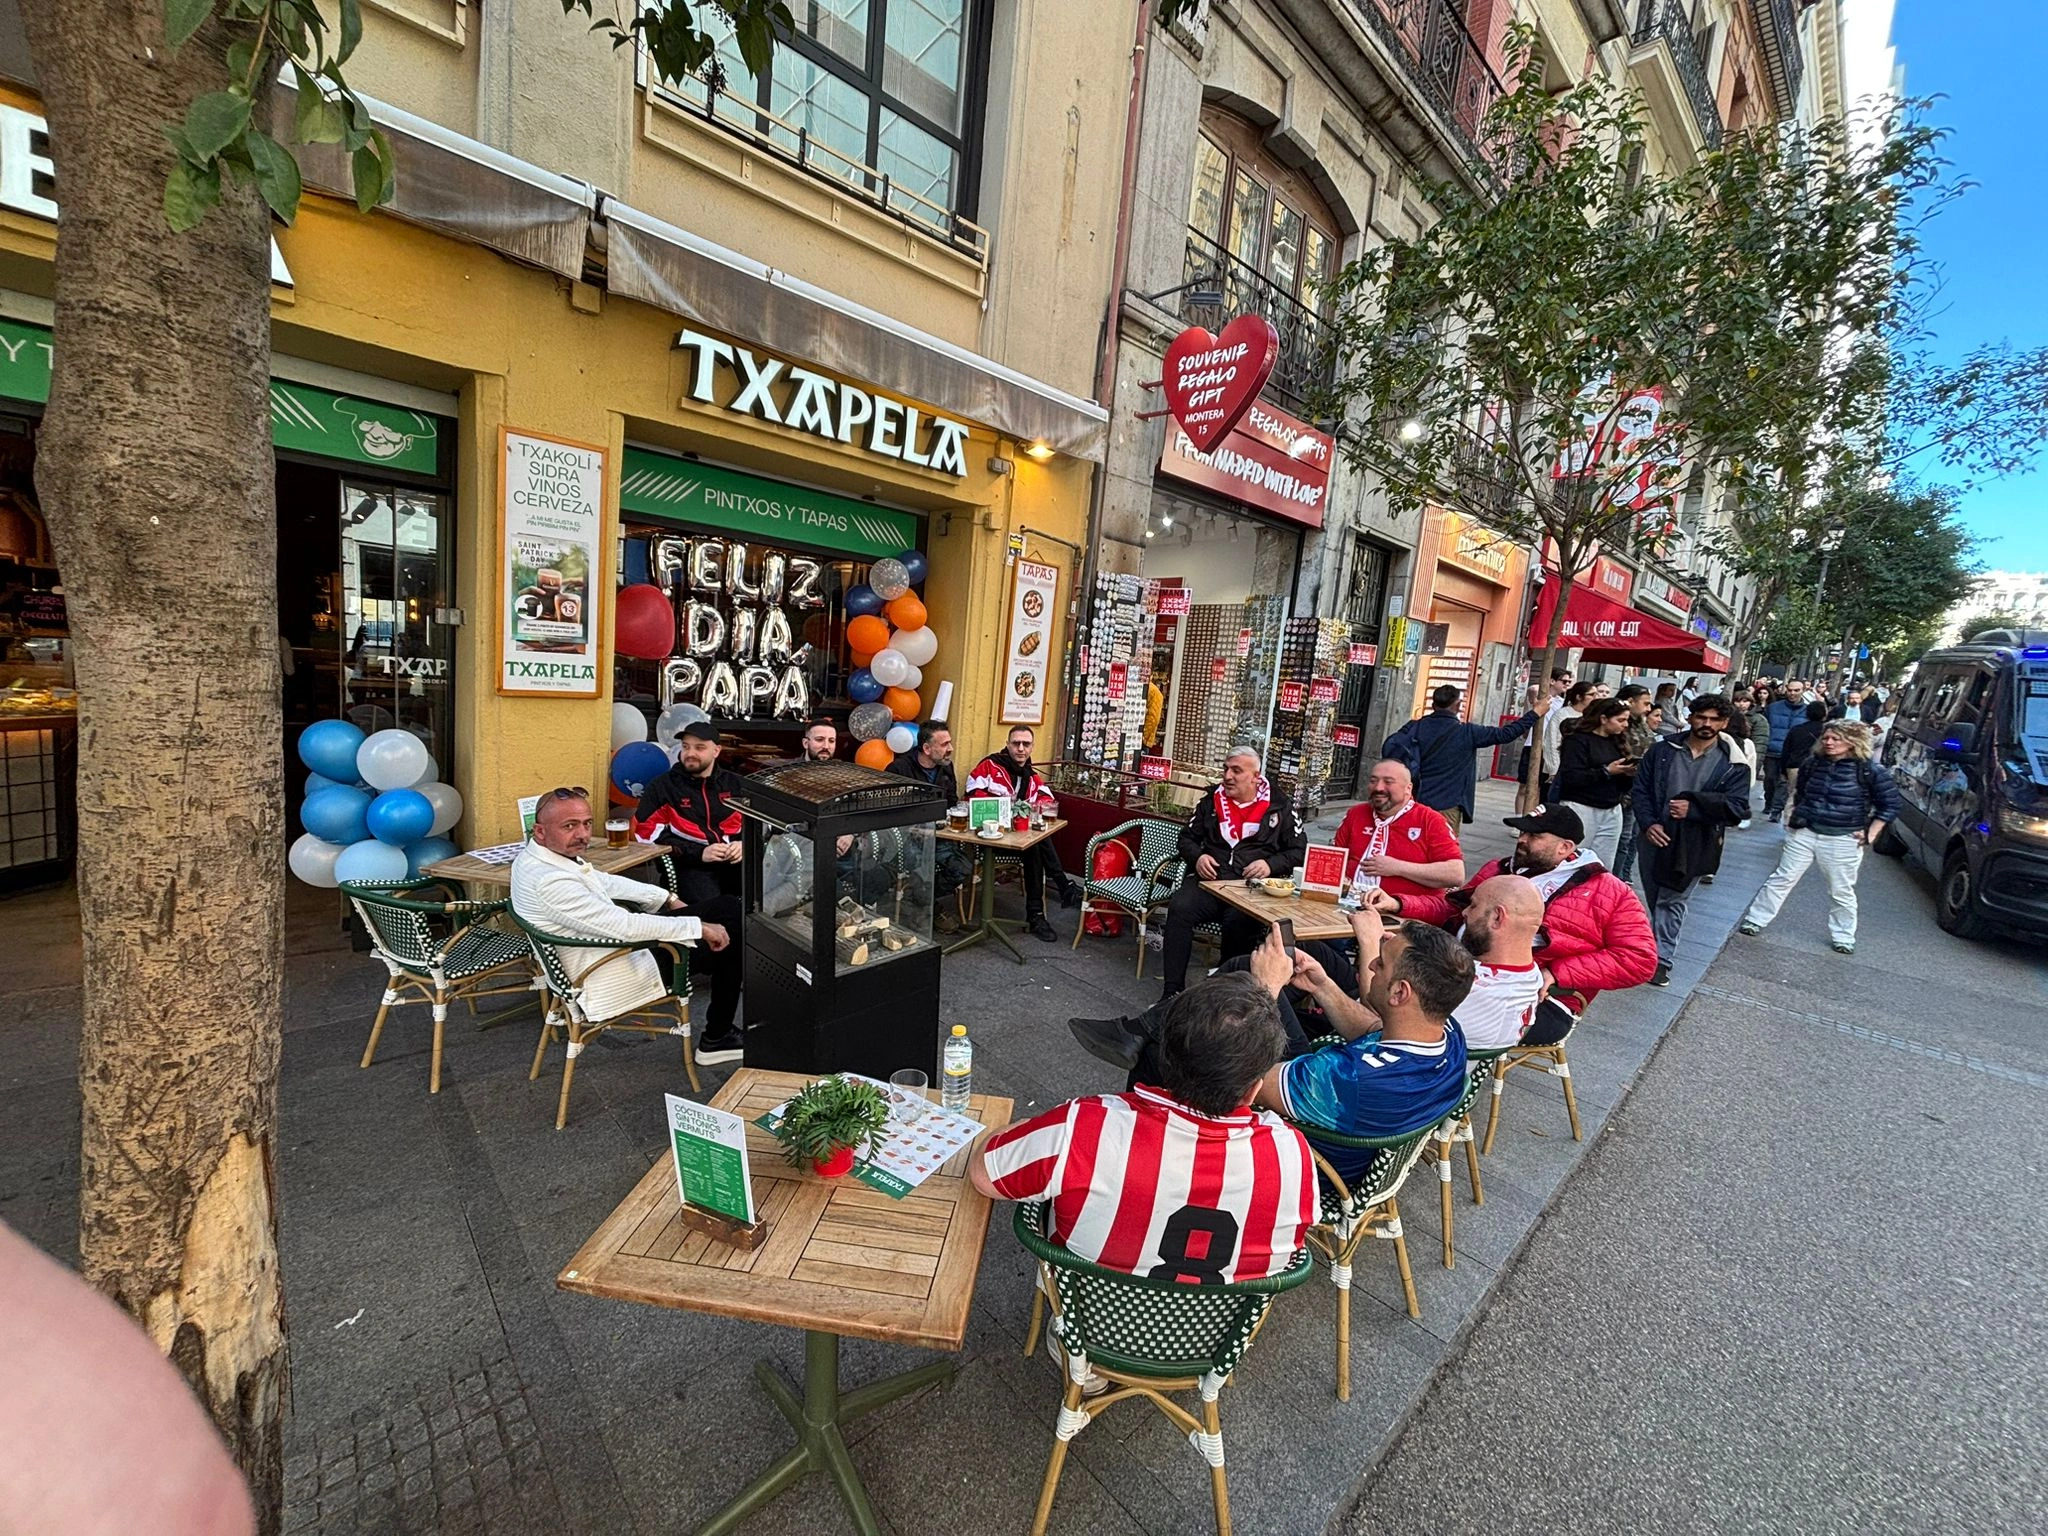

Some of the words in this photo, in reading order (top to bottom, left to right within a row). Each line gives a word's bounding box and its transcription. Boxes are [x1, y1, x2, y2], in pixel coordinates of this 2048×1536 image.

[1177, 342, 1249, 373] SOUVENIR
[1178, 366, 1237, 392] REGALO
[678, 328, 969, 478] TXAPELA
[1188, 386, 1226, 408] GIFT
[1184, 408, 1225, 424] MONTERA
[1249, 406, 1298, 445] REGALOS
[1198, 424, 1208, 435] 15
[528, 461, 581, 484] SIDRA
[1213, 447, 1265, 485] MADRID
[1264, 466, 1294, 499] WITH
[528, 476, 581, 499] VINOS
[513, 490, 594, 517] CERVEZA
[704, 487, 782, 520] PINTXOS
[785, 504, 796, 521] Y
[798, 507, 849, 533] TAPAS
[518, 541, 542, 550] SAINT
[651, 533, 826, 609] FELIZ
[1021, 563, 1054, 582] TAPAS
[563, 604, 575, 614] 13
[1387, 617, 1398, 659] HOSTAL
[1561, 621, 1579, 636] ALL
[1583, 621, 1591, 636] U
[1593, 621, 1615, 637] CAN
[1618, 621, 1641, 637] EAT
[505, 661, 594, 680] TXAPELA
[676, 1121, 715, 1140] VERMUTS
[871, 1171, 905, 1192] TXAPELA
[1147, 1204, 1239, 1285] 8
